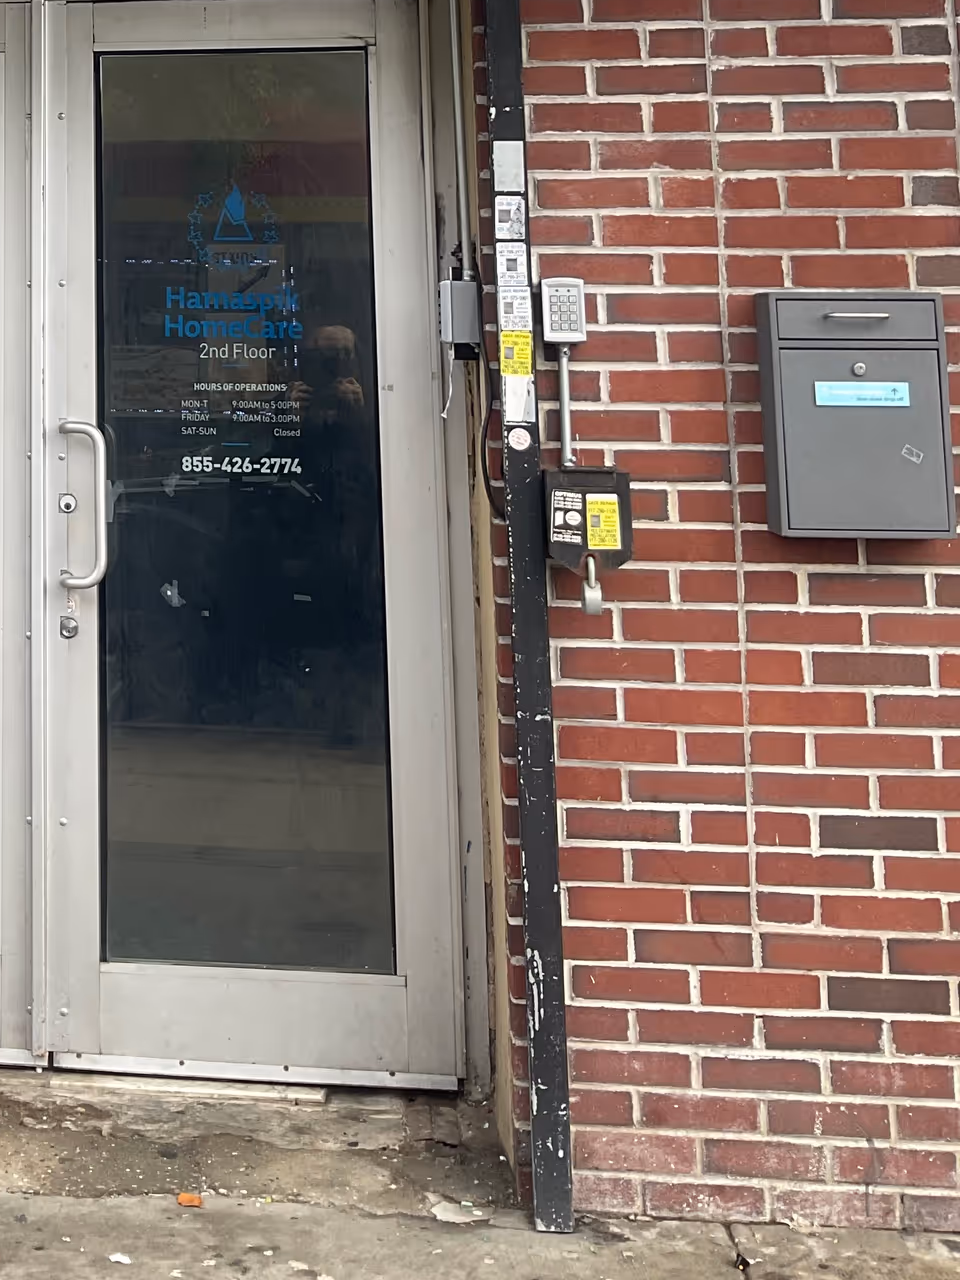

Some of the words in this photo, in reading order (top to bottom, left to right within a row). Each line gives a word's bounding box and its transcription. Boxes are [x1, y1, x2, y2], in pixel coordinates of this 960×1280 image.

[166, 285, 300, 316] Hamaspik
[164, 314, 304, 339] HomeCare
[199, 342, 228, 359] 2nd
[233, 342, 276, 359] Floor
[193, 382, 222, 391] HOURS
[223, 382, 233, 391] OF
[261, 401, 270, 409] to
[181, 413, 210, 421] FRIDAY
[181, 426, 217, 435] SAT-SUN
[273, 428, 301, 437] Closed
[181, 456, 302, 474] 855-426-2774
